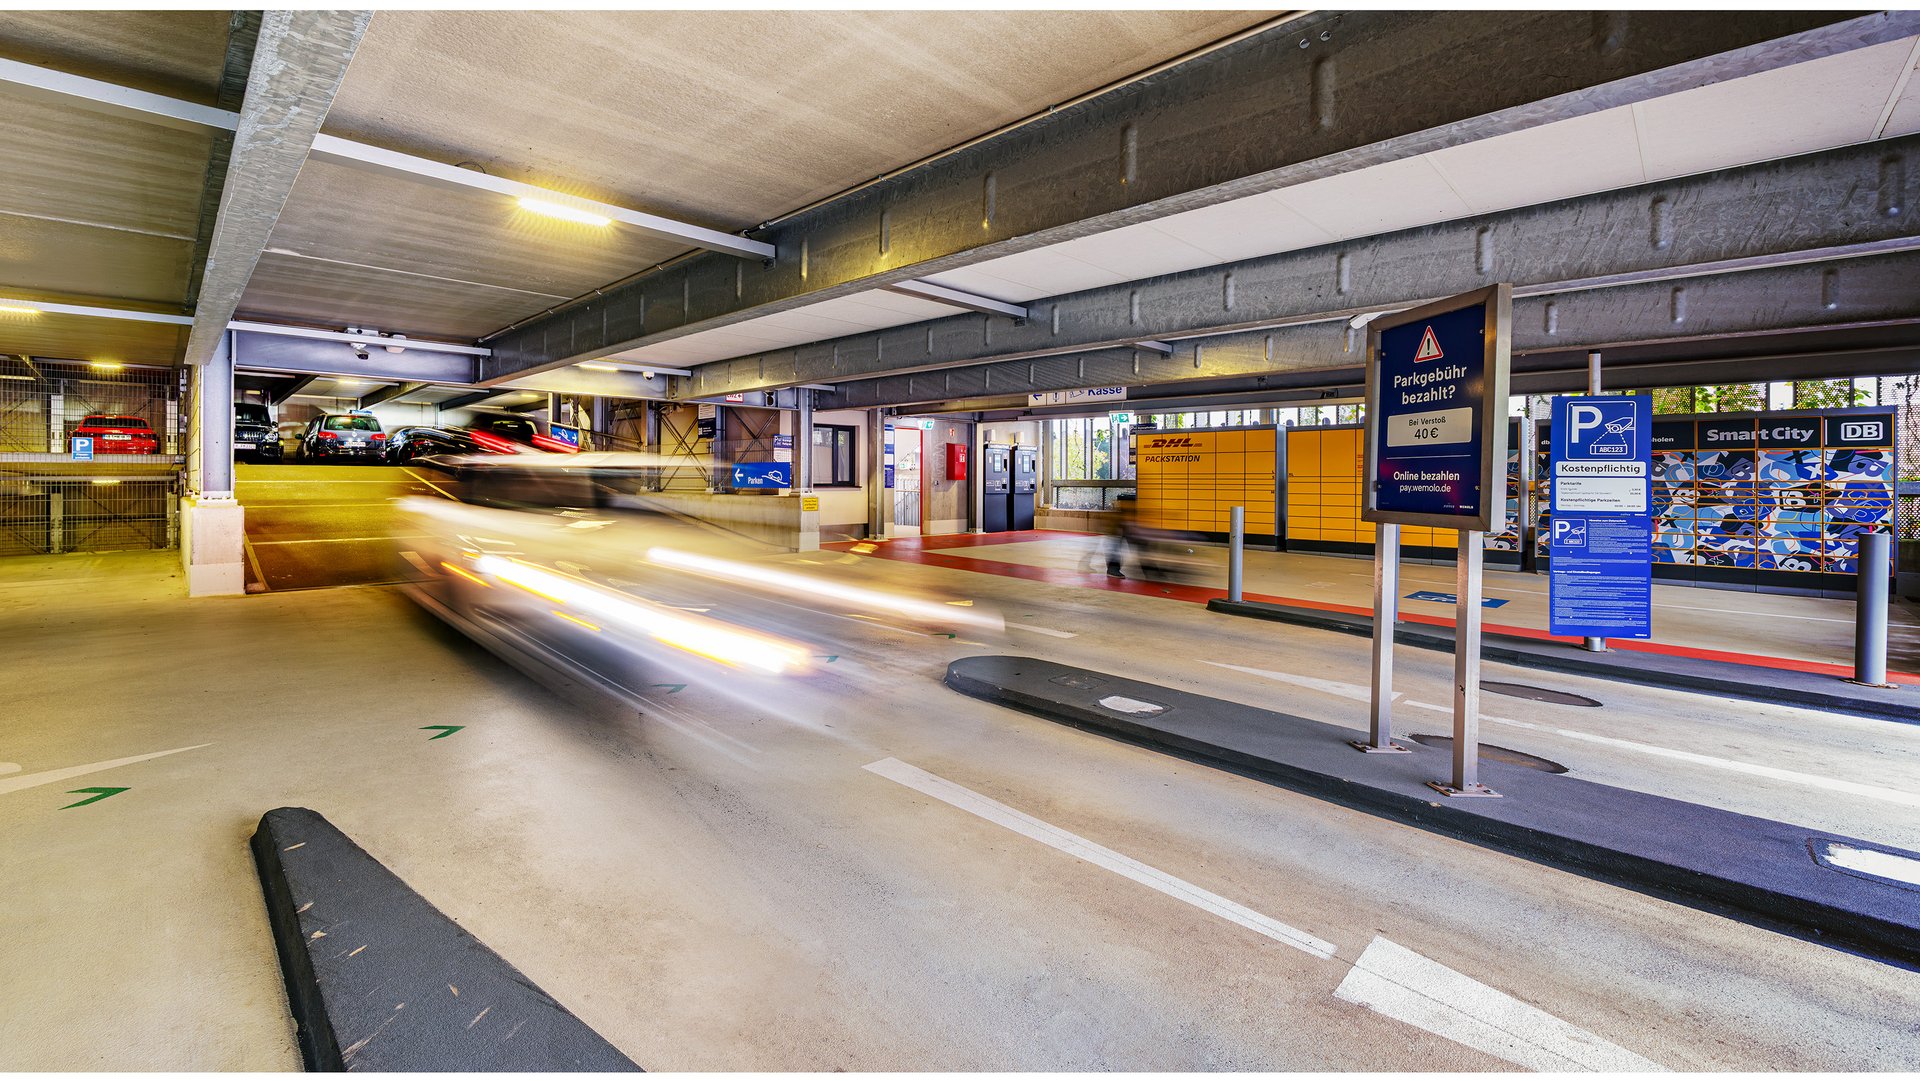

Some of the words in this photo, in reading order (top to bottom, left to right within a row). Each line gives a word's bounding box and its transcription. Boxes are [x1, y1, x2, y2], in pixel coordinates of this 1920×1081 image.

[1393, 364, 1468, 388] Parkgebühr
[1401, 385, 1456, 405] bezahlt?
[1408, 418, 1419, 426] Bei
[1420, 416, 1447, 425] Verstoß
[1571, 405, 1603, 444] P
[1706, 428, 1769, 441] Smart
[1772, 427, 1814, 442] City
[1846, 424, 1878, 438] DB
[75, 439, 89, 451] P
[1151, 438, 1194, 448] DHL
[1145, 454, 1201, 463] PACKSTATION
[1561, 464, 1641, 474] Kostenpflichtig
[747, 476, 763, 485] Parken
[1393, 470, 1419, 480] Online
[1420, 471, 1460, 481] bezahlen
[1399, 483, 1452, 493] pay.wemolo.de
[1555, 520, 1571, 539] P
